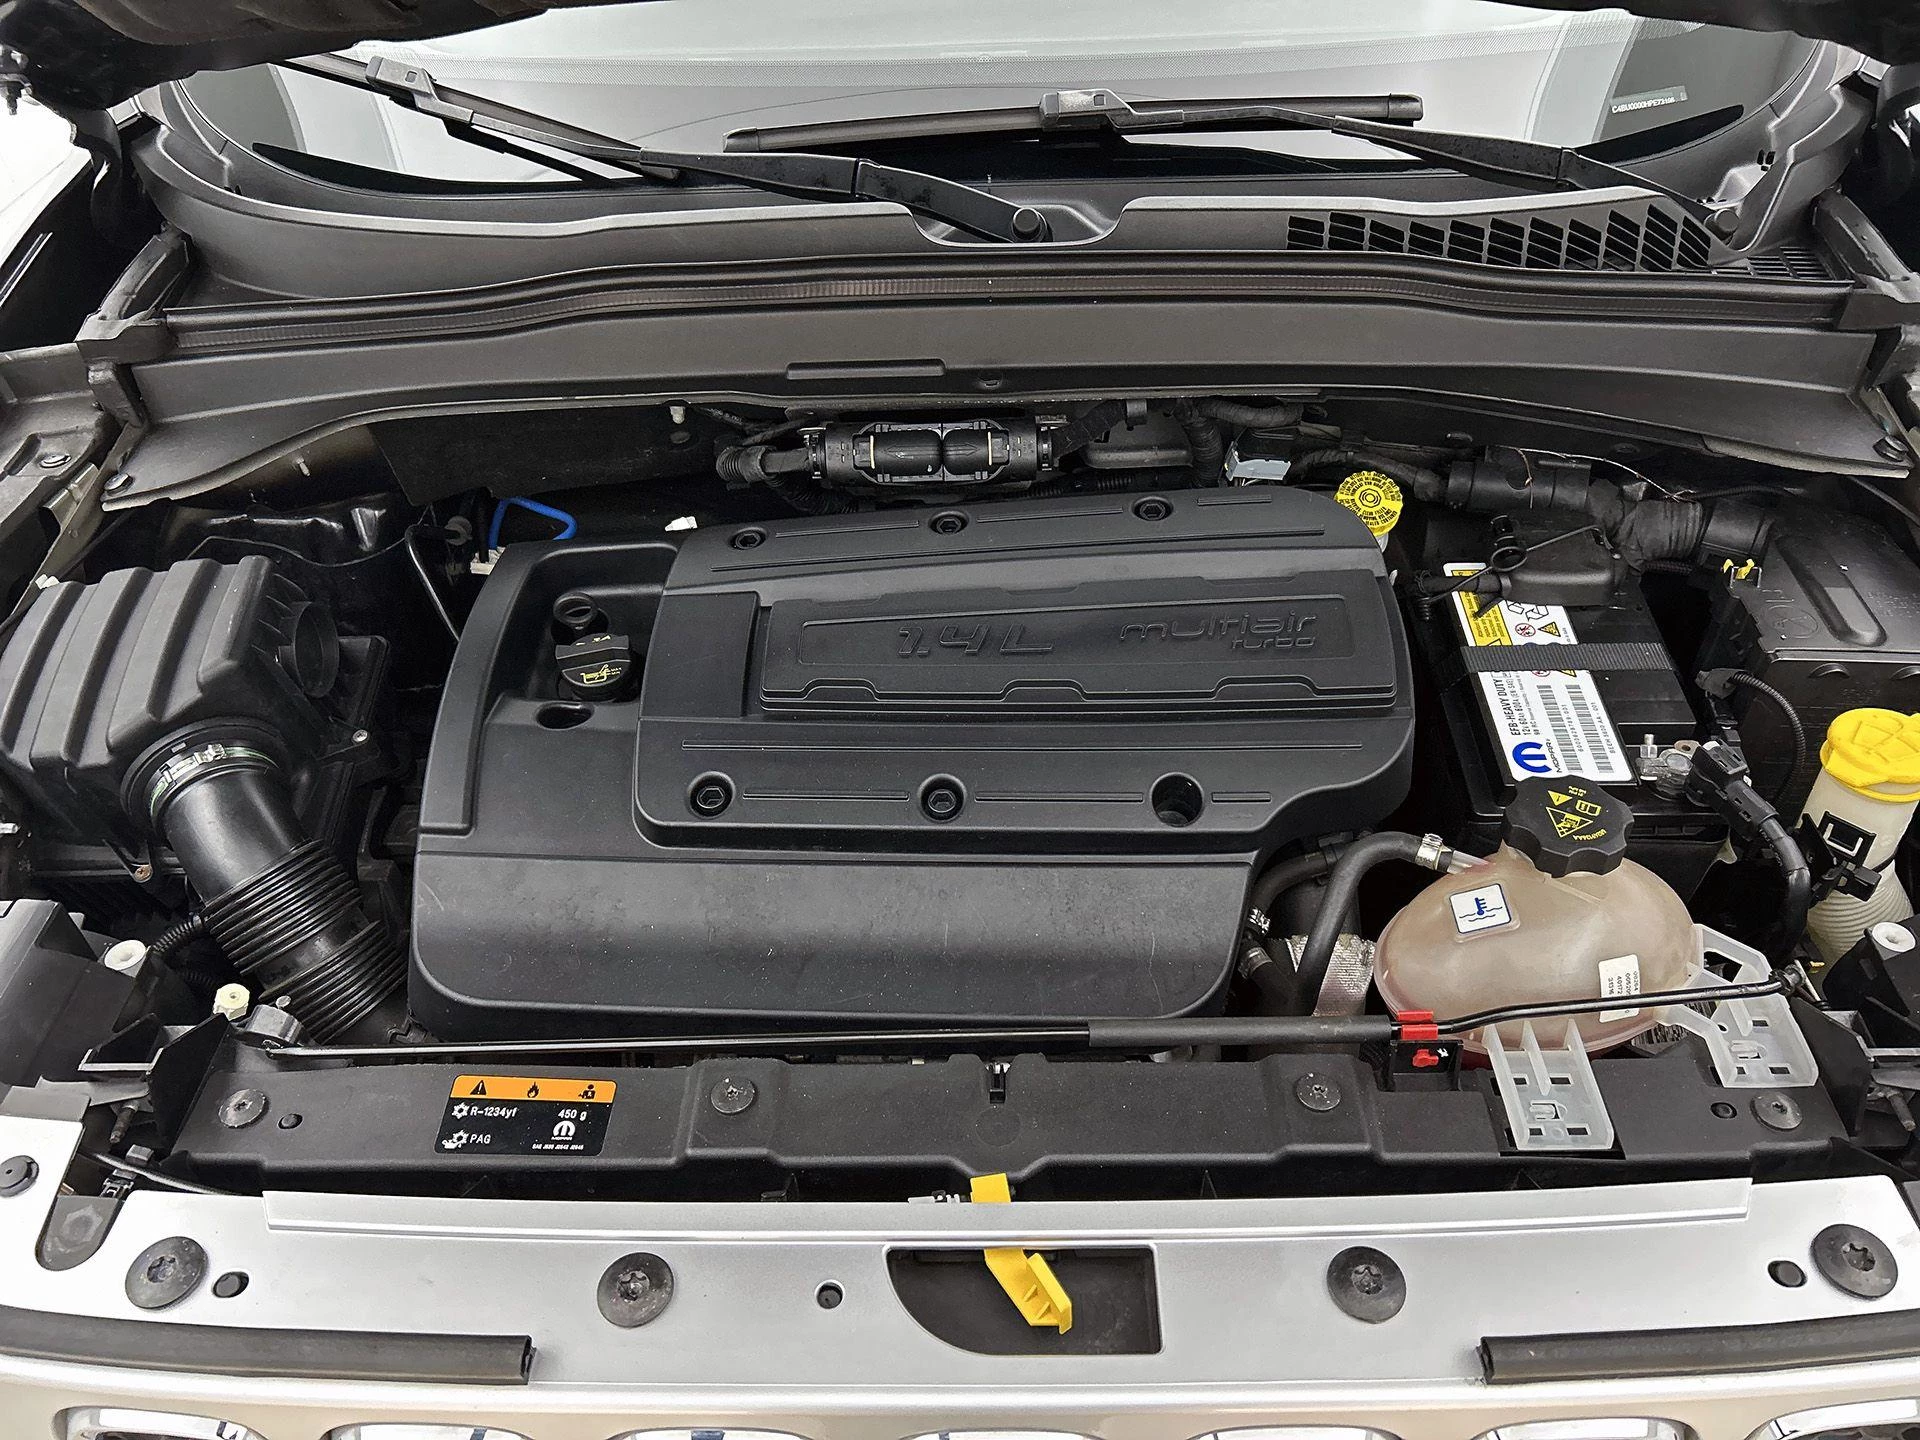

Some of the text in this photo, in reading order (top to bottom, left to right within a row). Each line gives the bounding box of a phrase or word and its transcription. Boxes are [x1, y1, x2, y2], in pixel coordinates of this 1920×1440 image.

[1119, 609, 1318, 641] multiair
[898, 622, 990, 657] 1.4
[1230, 634, 1316, 650] turbo
[1493, 679, 1509, 697] DUTY
[1498, 697, 1521, 736] EFB-HEAVY
[470, 1106, 588, 1121] R-1234yf 450 g
[469, 1133, 491, 1144] PAG
